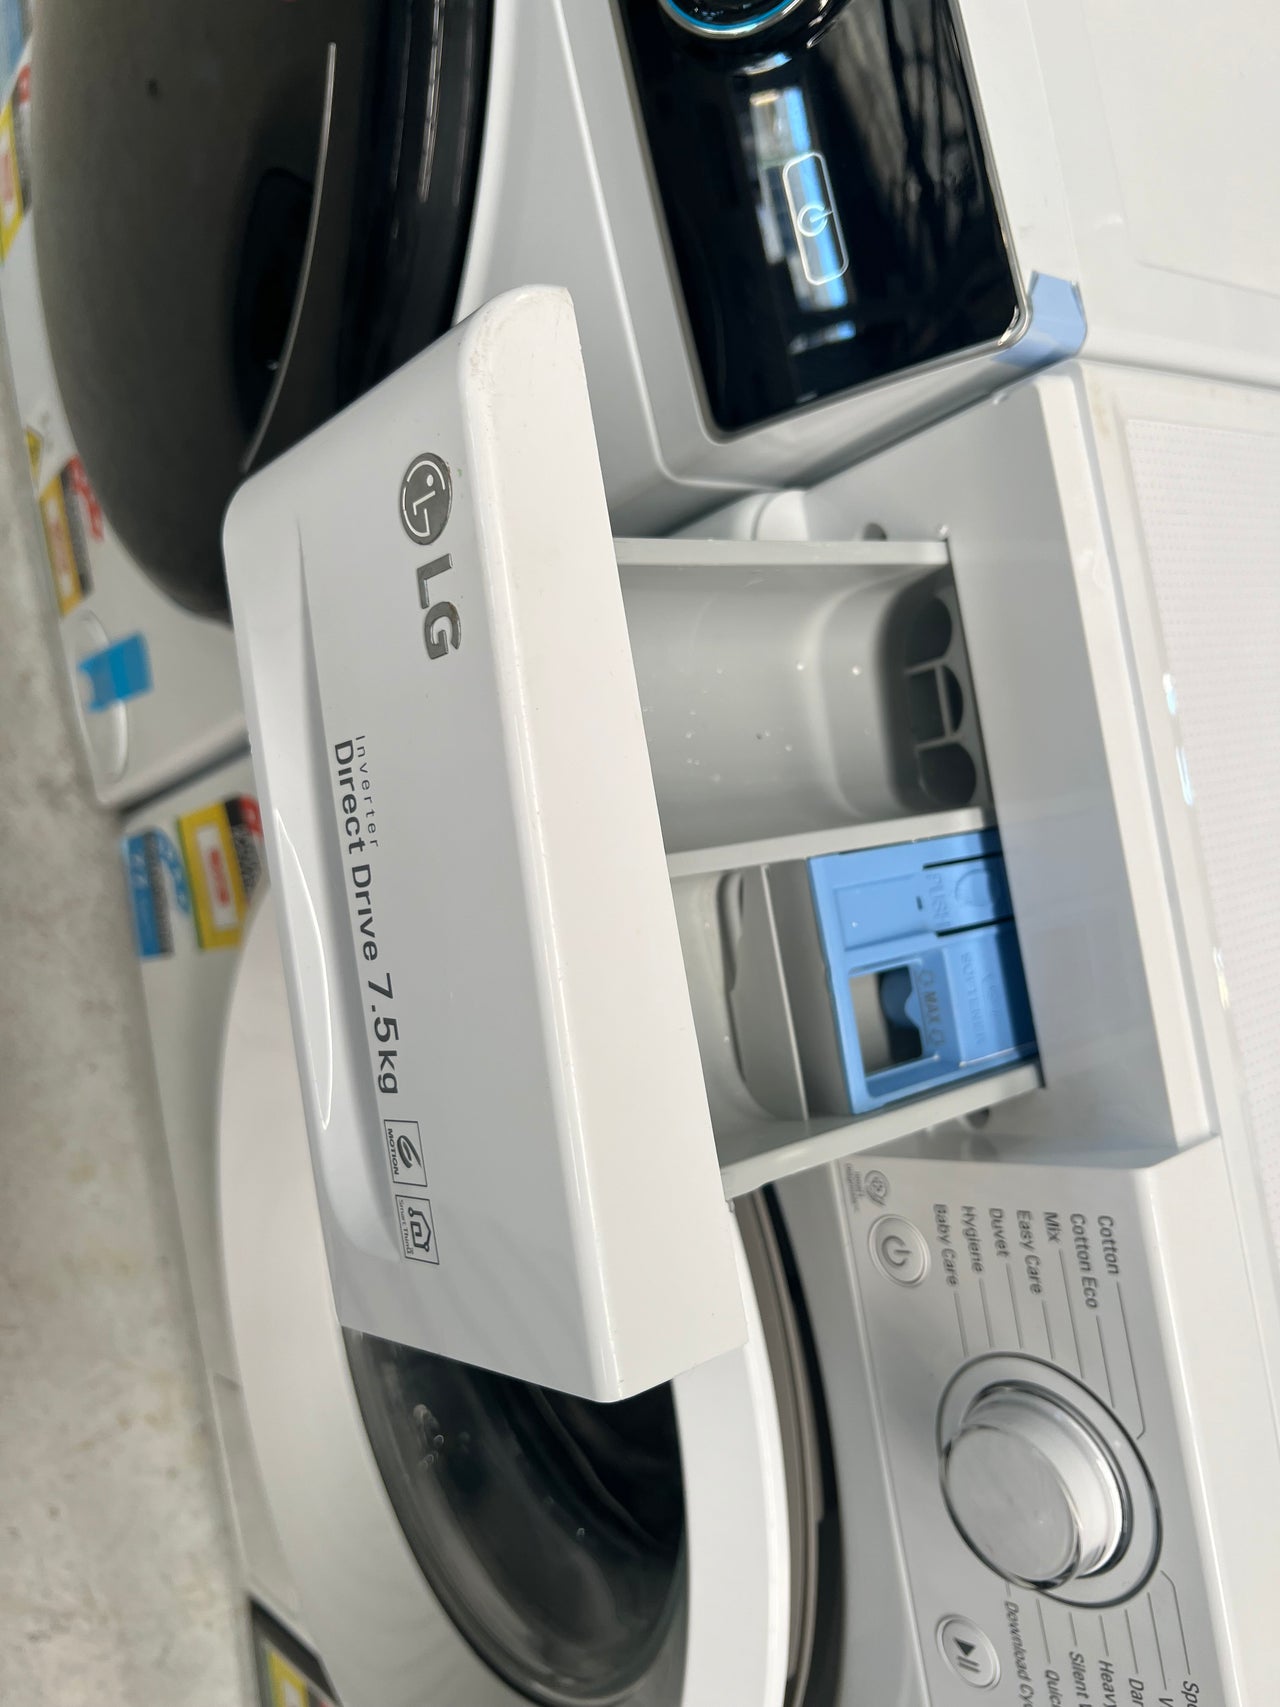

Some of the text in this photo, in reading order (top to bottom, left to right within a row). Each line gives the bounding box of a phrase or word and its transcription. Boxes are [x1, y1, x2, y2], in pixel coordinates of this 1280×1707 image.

[417, 553, 461, 660] LG
[356, 735, 378, 847] Inverter
[335, 740, 366, 854] Direct
[352, 864, 378, 961] Drive
[924, 990, 943, 1025] MAX
[387, 1128, 400, 1175] MOTION
[933, 1203, 957, 1288] Baby Care
[961, 1205, 984, 1274] Hygiene
[989, 1207, 1009, 1258] Duvet
[1016, 1209, 1043, 1295] Easy Care
[1043, 1211, 1061, 1243] Mix
[1070, 1213, 1098, 1309] Cotton Eco
[1097, 1214, 1120, 1275] Cotton
[1005, 1601, 1032, 1682] Download
[1069, 1651, 1090, 1700] Silent
[1045, 1669, 1063, 1707] Quic
